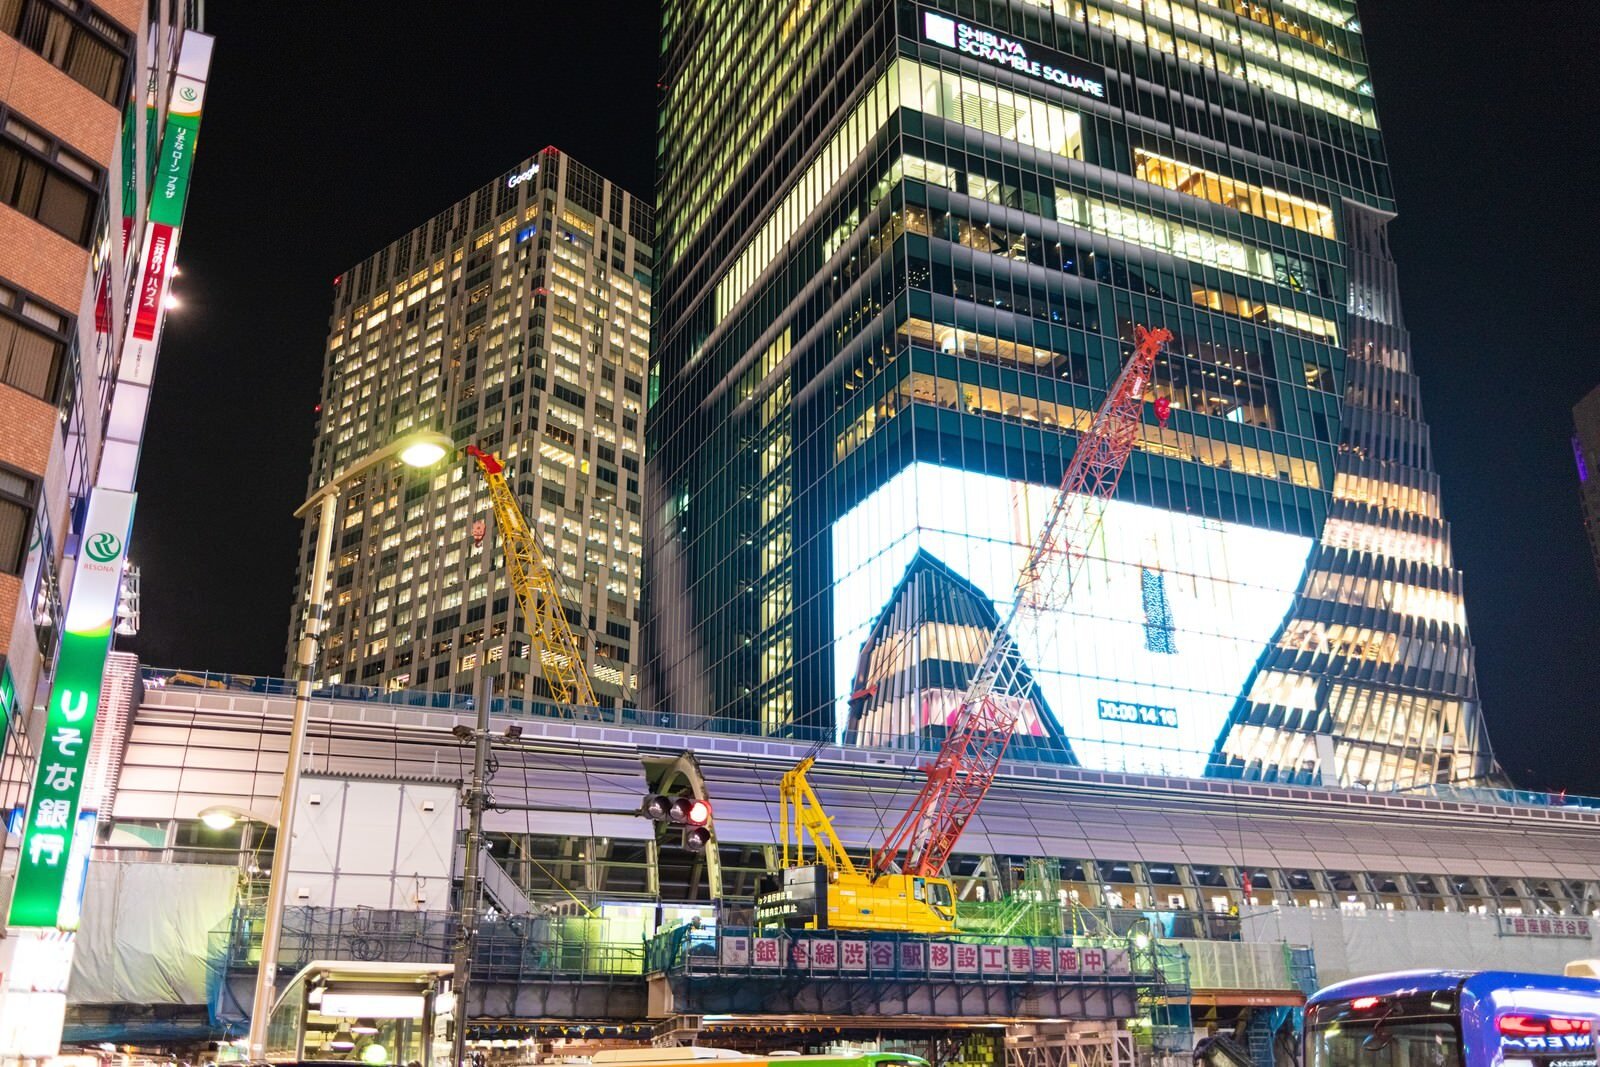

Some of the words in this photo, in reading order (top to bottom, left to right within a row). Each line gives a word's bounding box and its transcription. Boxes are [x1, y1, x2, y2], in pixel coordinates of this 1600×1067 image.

[958, 24, 1026, 58] SHIBUYA
[958, 38, 1041, 77] SCRAMBLE
[1042, 65, 1105, 97] SQUARE
[508, 163, 540, 188] Google
[83, 563, 114, 572] RESONA
[29, 688, 89, 867] りそな銀行
